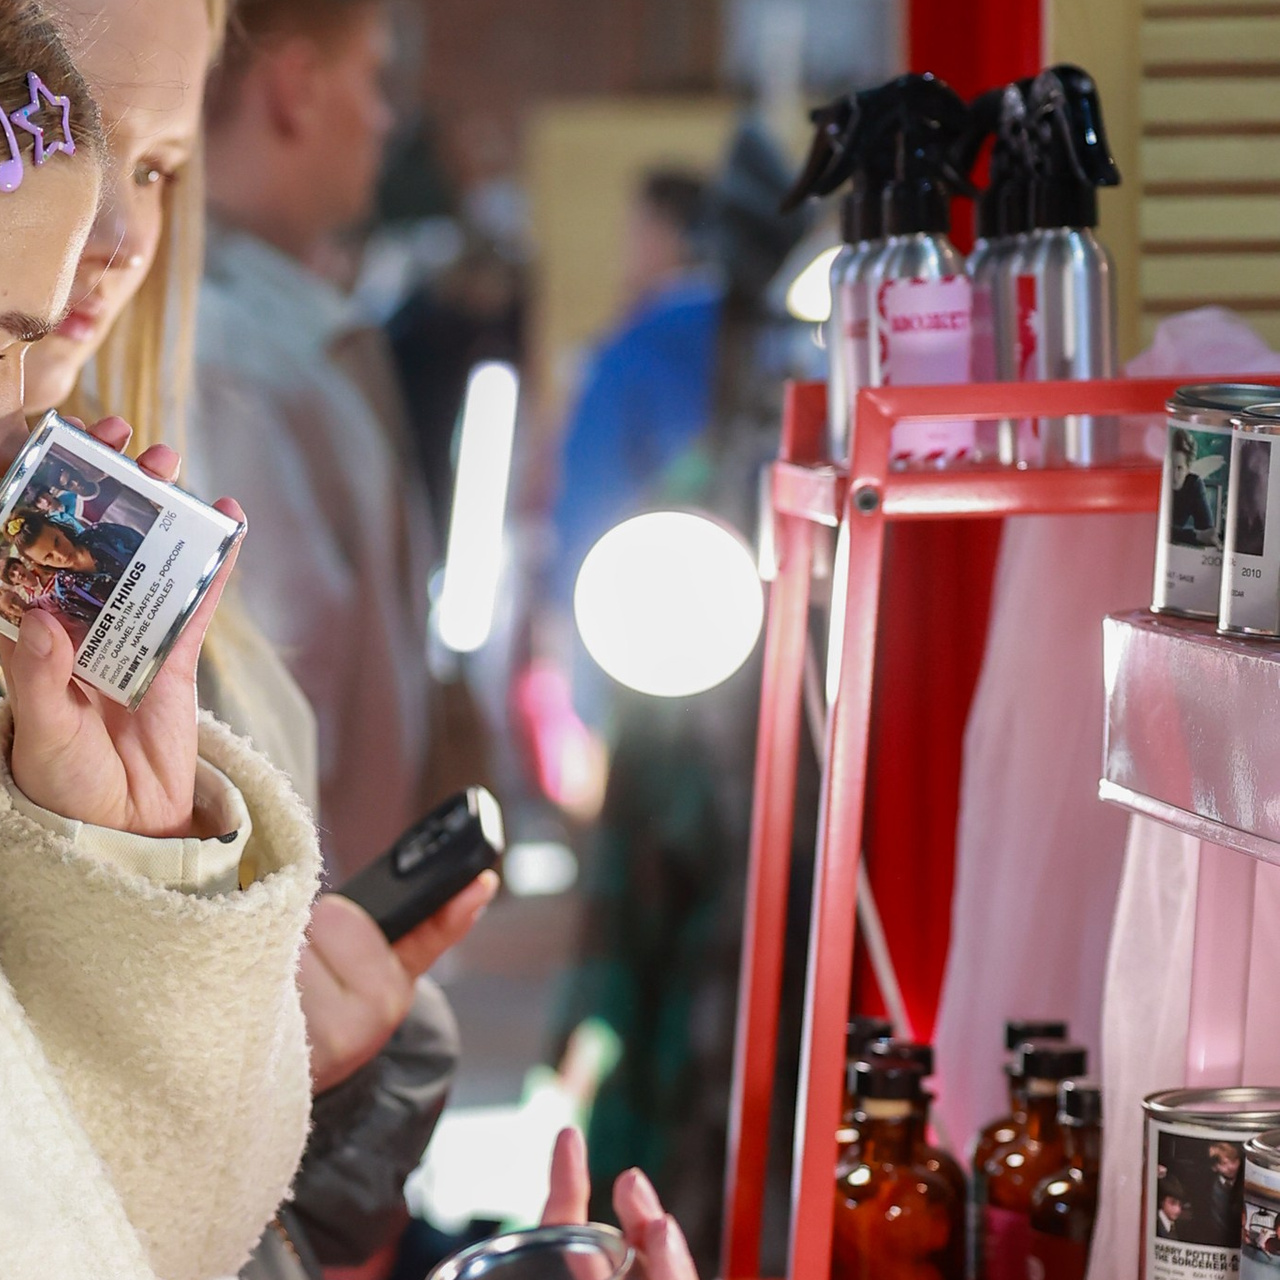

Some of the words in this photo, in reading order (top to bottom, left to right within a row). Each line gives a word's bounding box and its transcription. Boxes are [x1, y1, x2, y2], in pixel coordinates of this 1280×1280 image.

[159, 510, 177, 532] 2016
[1202, 555, 1222, 566] 200
[1242, 567, 1261, 578] 2010
[111, 625, 135, 659] CARAMEL
[134, 581, 160, 620] WAFFLES
[159, 540, 185, 577] POPCORN
[77, 613, 116, 669] STRANGER
[110, 561, 147, 612] THINGS
[121, 655, 130, 666] by
[130, 620, 151, 648] MAYBE
[147, 578, 176, 621] CANDLES?
[101, 638, 113, 654] time
[138, 645, 149, 657] LIE
[1185, 1249, 1227, 1262] POTTER
